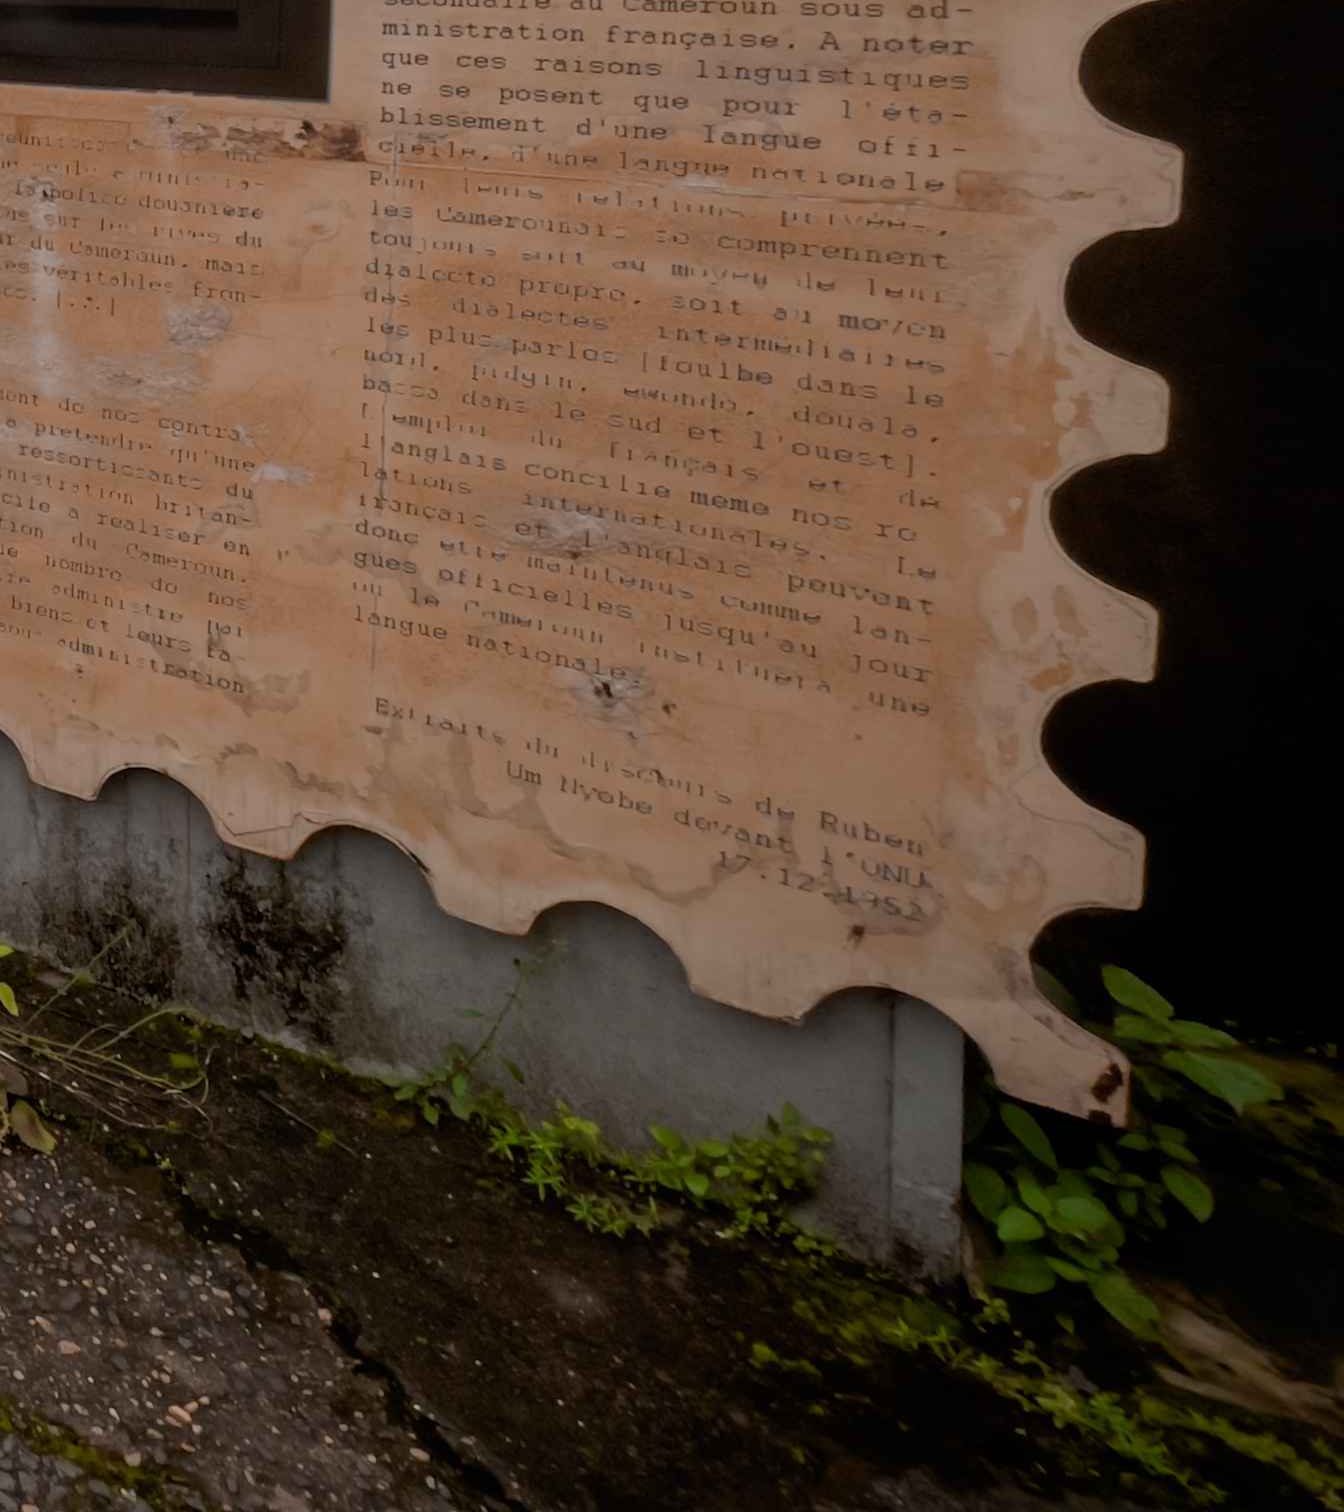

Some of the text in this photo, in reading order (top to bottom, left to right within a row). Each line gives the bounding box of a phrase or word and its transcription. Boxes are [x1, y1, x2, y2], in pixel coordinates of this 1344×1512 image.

[800, 2, 883, 18] sous
[907, 0, 973, 19] ad-
[382, 22, 974, 56] ministration française. A noter
[382, 52, 969, 92] que ces raisons linguistiques
[381, 81, 412, 95] ne
[440, 84, 470, 98] se
[499, 87, 602, 105] posent
[633, 95, 688, 113] que
[722, 98, 800, 117] pour
[380, 106, 546, 133] blissement
[576, 118, 667, 140] d'une
[703, 124, 821, 151] langue
[716, 234, 951, 270] comprennent
[906, 384, 945, 408] le
[688, 425, 723, 444] et
[791, 506, 853, 531] nos
[354, 550, 417, 575] gues
[353, 605, 448, 640] langue
